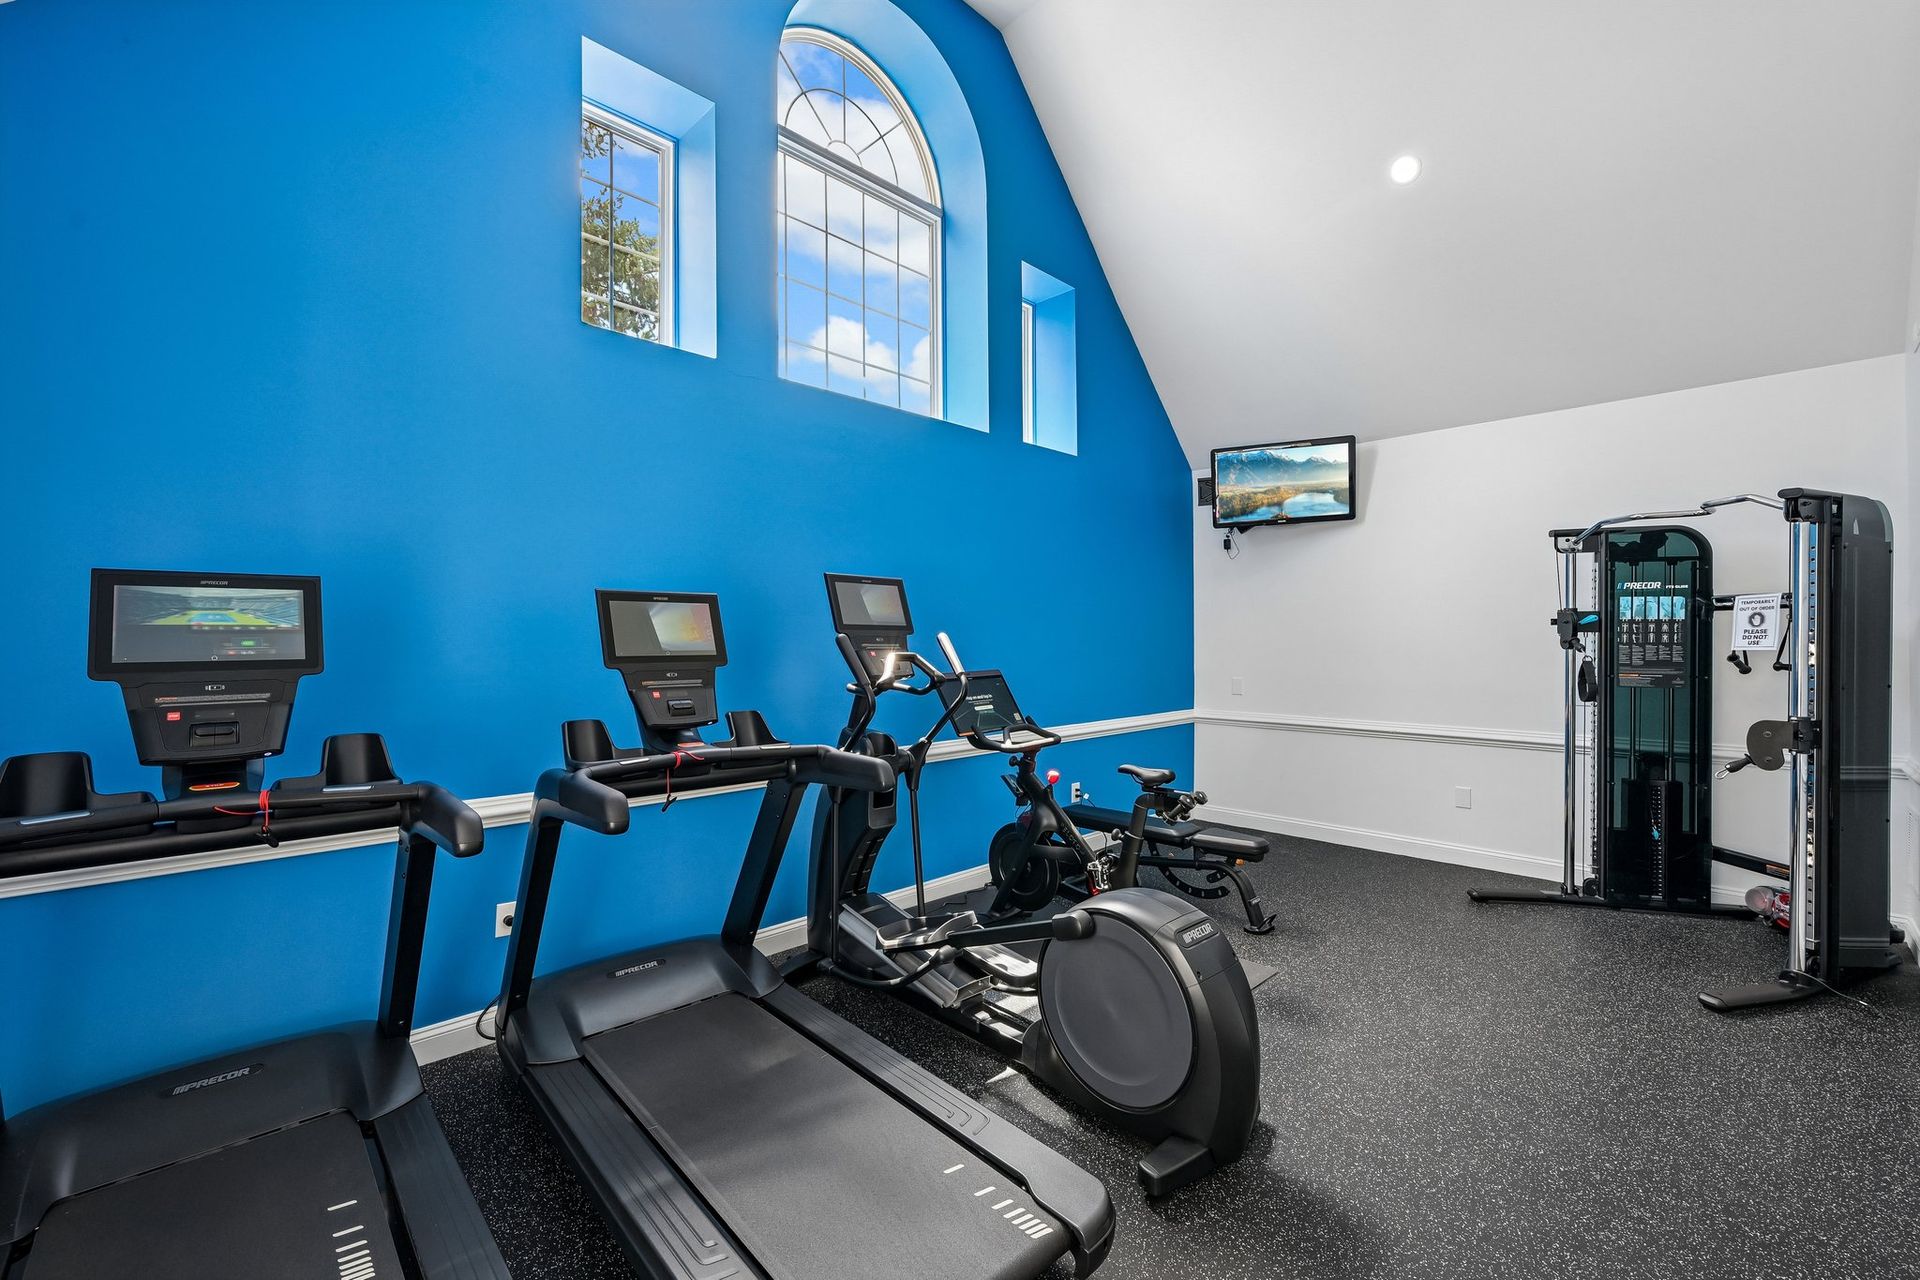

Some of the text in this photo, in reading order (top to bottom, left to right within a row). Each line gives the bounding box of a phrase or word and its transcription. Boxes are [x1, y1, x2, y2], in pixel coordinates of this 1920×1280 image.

[1623, 581, 1661, 589] PRECOR
[1187, 923, 1214, 942] PRECOR
[621, 961, 658, 975] PRECOR
[182, 1067, 250, 1093] PRECOR
